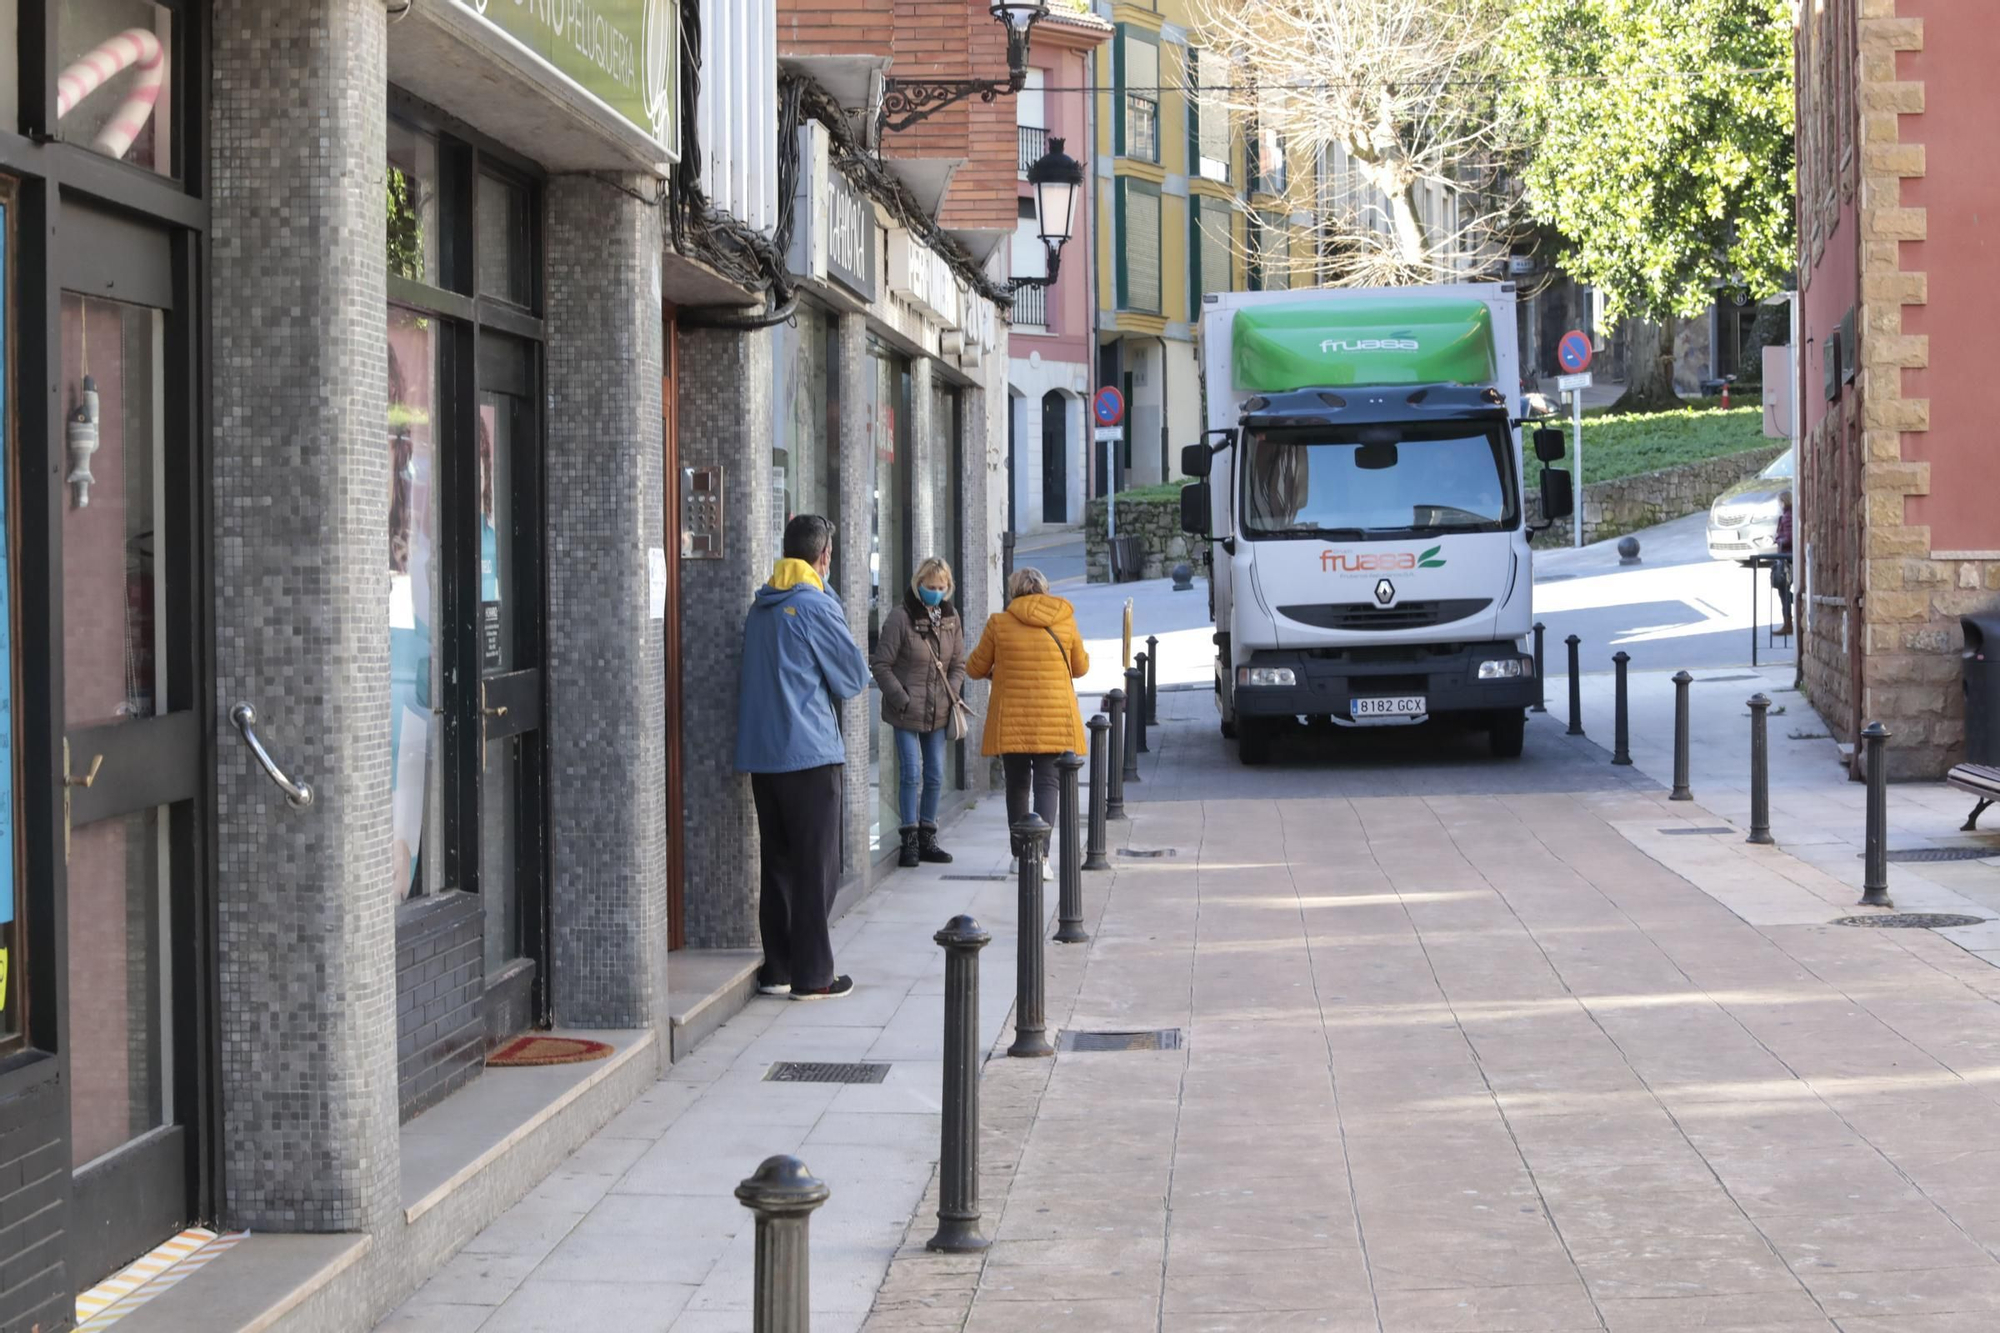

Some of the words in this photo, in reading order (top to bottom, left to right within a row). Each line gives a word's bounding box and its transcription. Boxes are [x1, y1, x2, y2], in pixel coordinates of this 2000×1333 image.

[1319, 339, 1419, 353] fruasa
[1319, 550, 1416, 572] fruasa
[1361, 700, 1393, 712] 8182
[1397, 699, 1422, 711] GCX
